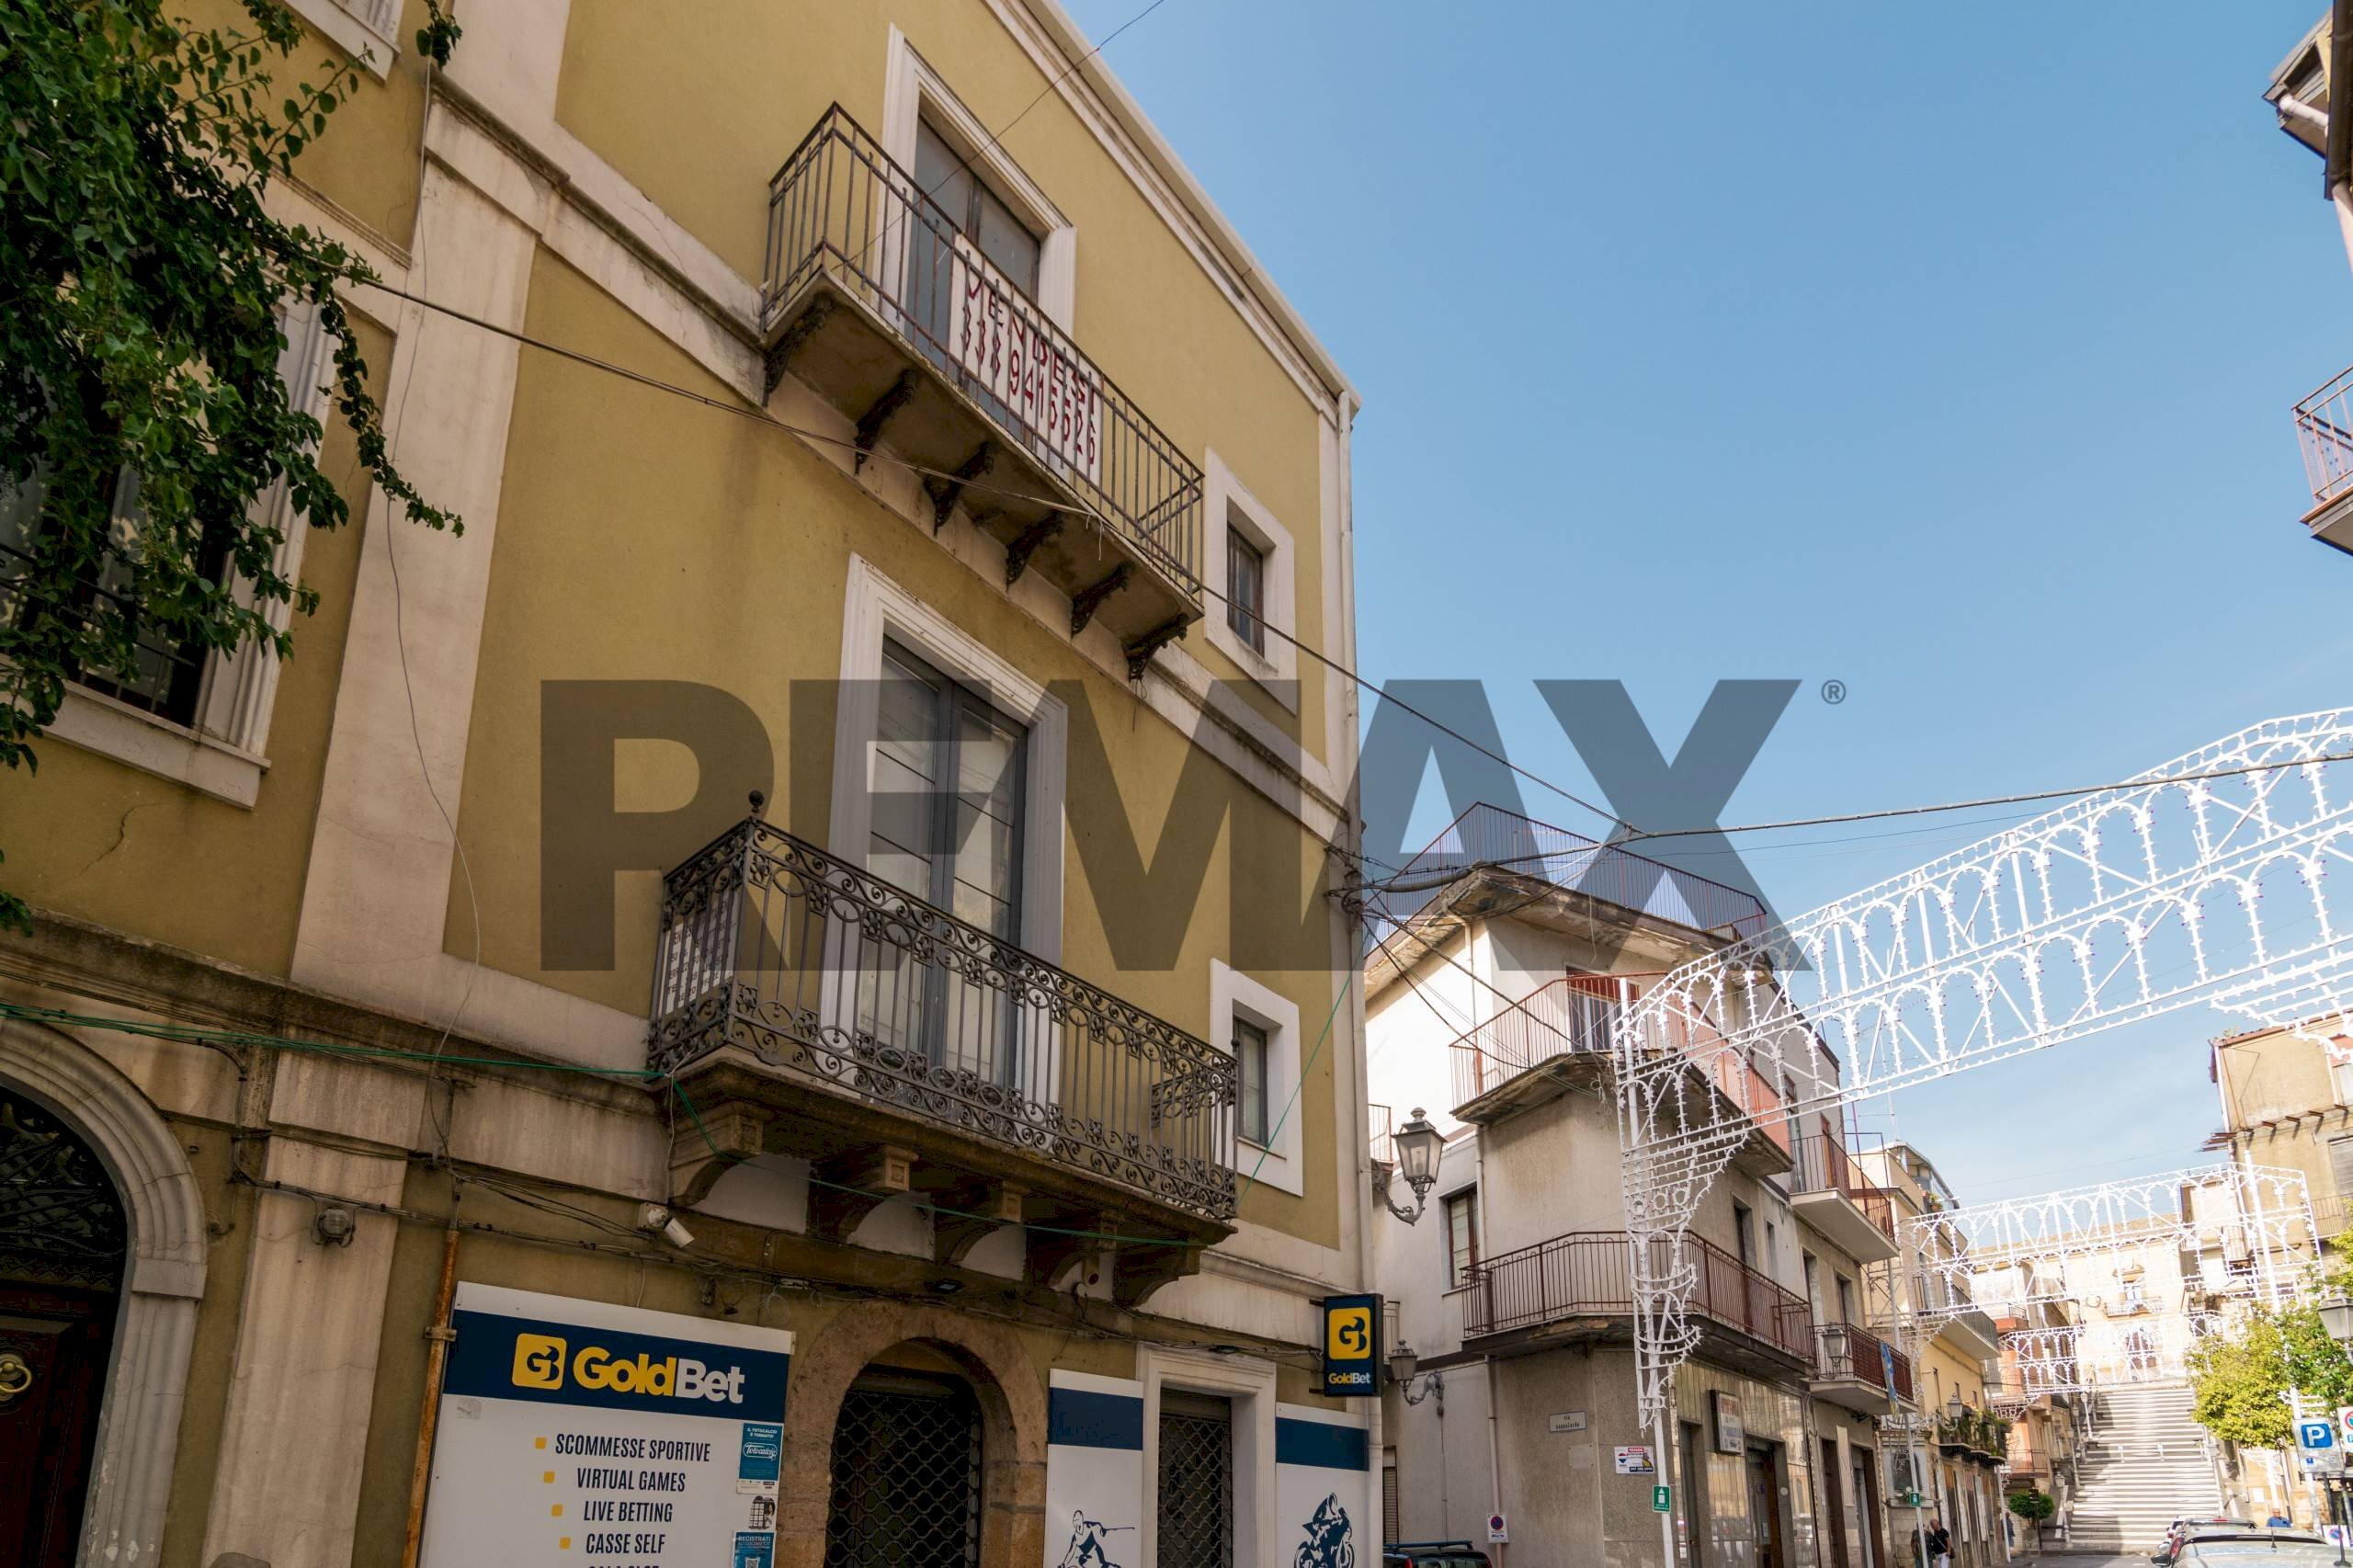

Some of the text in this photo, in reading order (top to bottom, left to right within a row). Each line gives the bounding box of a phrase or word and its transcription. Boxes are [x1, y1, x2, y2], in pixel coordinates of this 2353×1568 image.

[573, 1346, 745, 1404] GoldBet
[1328, 1371, 1371, 1384] GoldBet
[555, 1433, 711, 1462] SCOMMESSE SPORTIVE
[577, 1467, 687, 1493] VIRTUAL GAMES
[583, 1500, 673, 1523] LIVE BETTING
[585, 1533, 666, 1554] CASSE SELF
